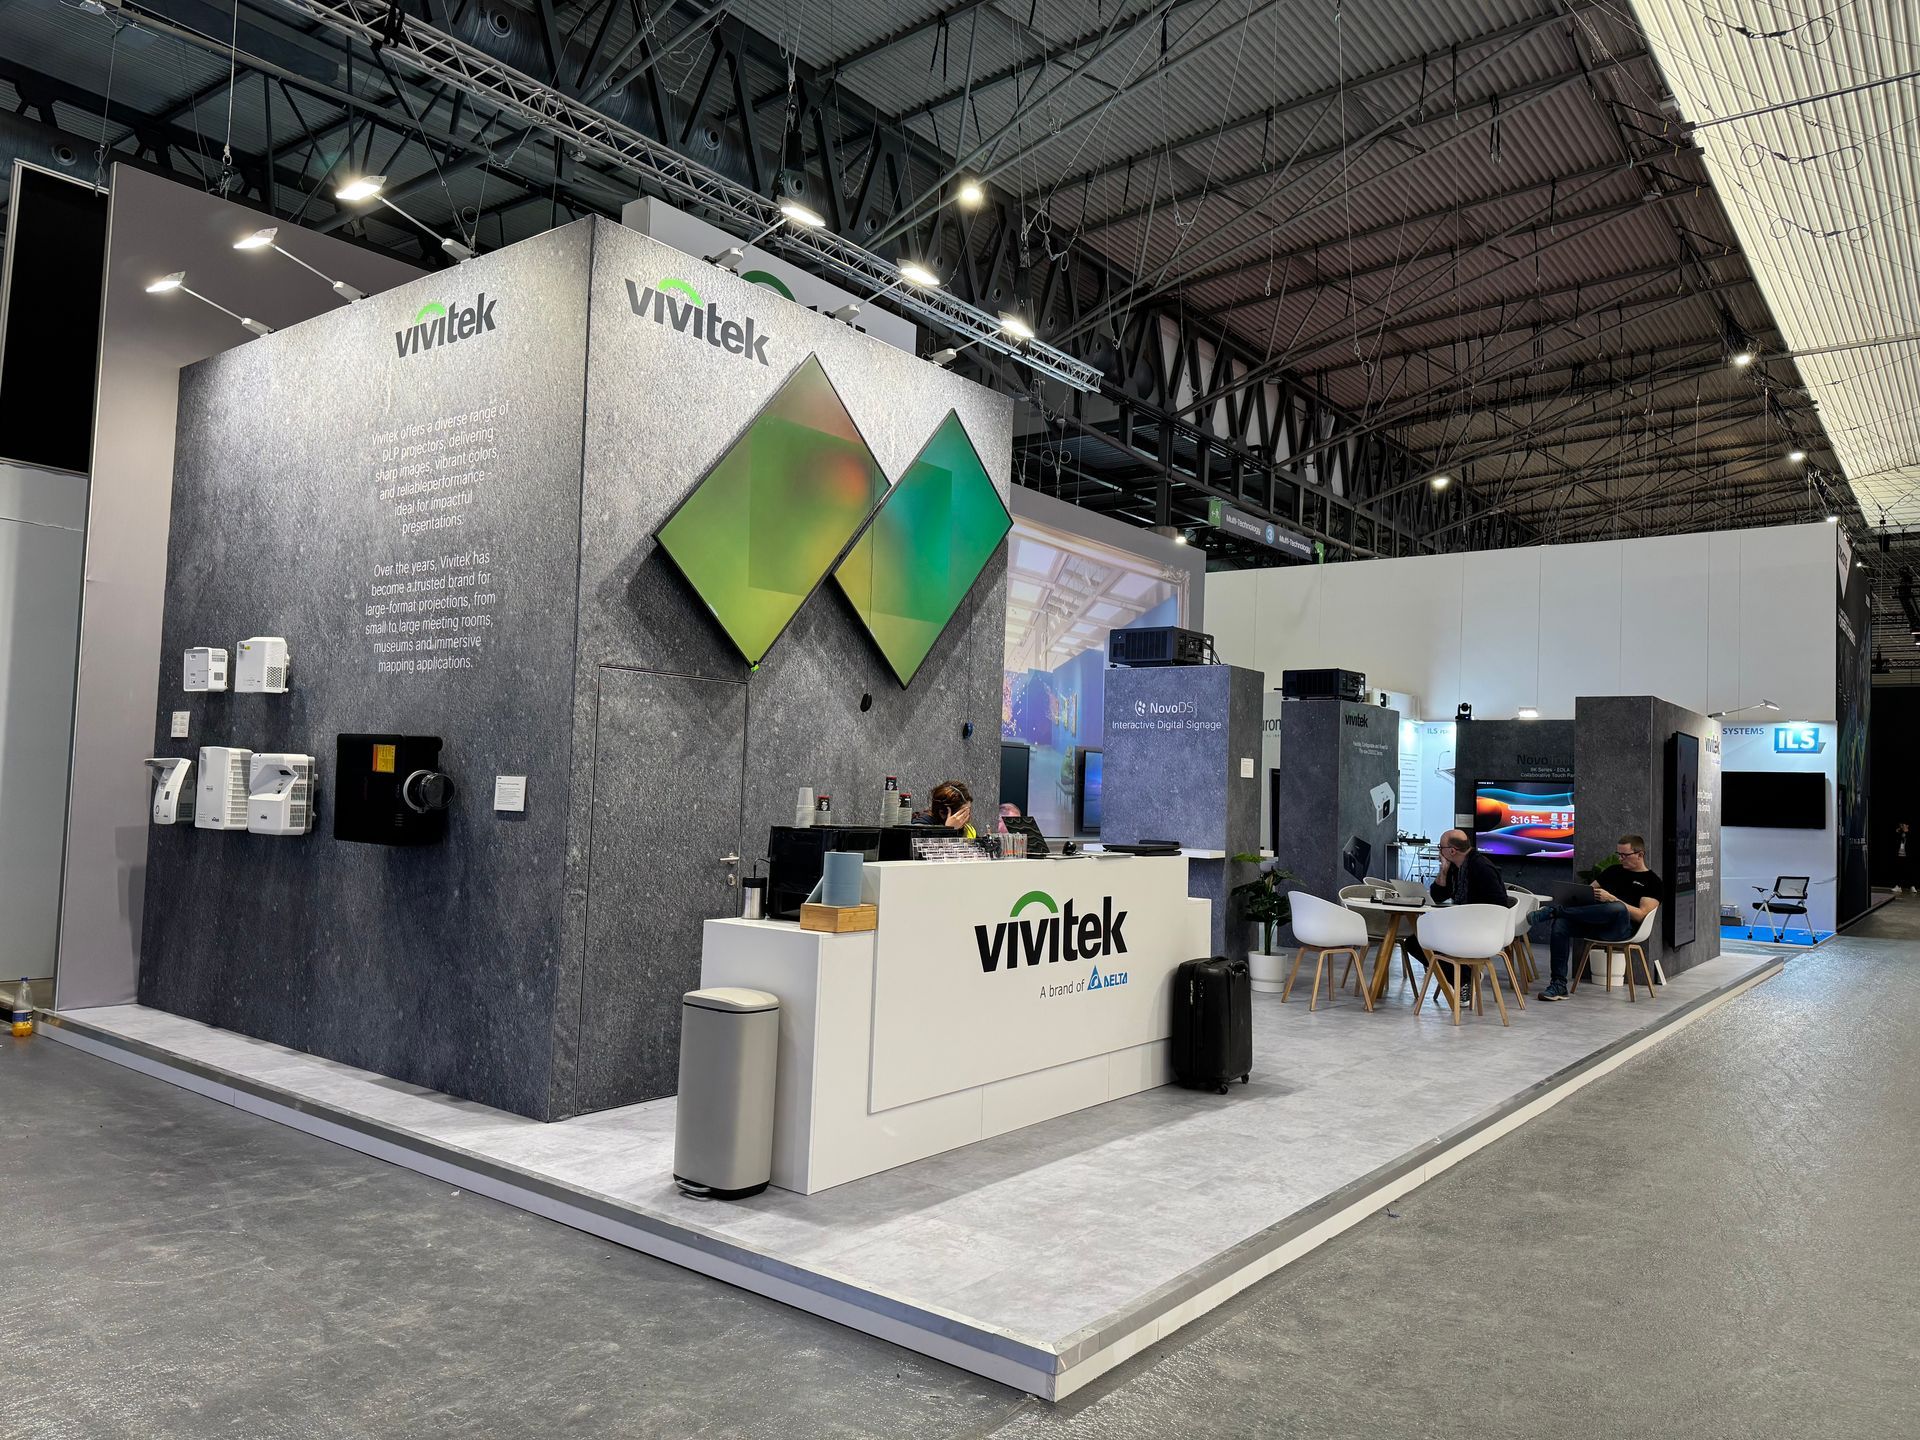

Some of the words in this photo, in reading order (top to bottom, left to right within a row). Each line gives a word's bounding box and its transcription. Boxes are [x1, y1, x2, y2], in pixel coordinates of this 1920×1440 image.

[395, 292, 498, 359] vivitek
[628, 278, 770, 367] vivitek
[371, 429, 399, 447] Vivitek
[400, 422, 425, 440] offers
[427, 422, 433, 433] a
[435, 413, 468, 432] diverse
[469, 408, 497, 427] range
[499, 400, 510, 416] of
[382, 447, 400, 463] DLP
[401, 438, 447, 463] projectors,
[448, 426, 494, 448] delivering
[375, 466, 398, 484] sharp
[400, 459, 433, 480] images,
[435, 450, 467, 470] vibrant
[379, 485, 395, 501] and
[394, 500, 415, 517] ideal
[416, 497, 429, 513] for
[430, 490, 473, 511] impactful
[1225, 514, 1261, 536] Multi-Technology
[1267, 529, 1273, 541] 3
[1278, 535, 1311, 554] Multi-Technology
[374, 563, 394, 578] Over
[395, 560, 410, 575] the
[411, 559, 438, 577] years,
[440, 552, 471, 570] Vivitek
[473, 550, 490, 565] has
[371, 582, 405, 598] become
[406, 583, 413, 593] a
[414, 575, 446, 592] trusted
[448, 572, 476, 589] brand
[477, 570, 491, 585] for
[365, 600, 417, 619] large-format
[418, 594, 472, 615] projections,
[474, 590, 496, 606] from
[365, 620, 387, 636] small
[388, 621, 398, 633] to
[398, 618, 421, 636] large
[422, 614, 460, 633] meeting
[461, 613, 494, 630] rooms,
[373, 638, 414, 654] museums
[415, 636, 432, 651] and
[434, 633, 482, 650] immersive
[378, 659, 415, 676] mapping
[416, 654, 473, 672] applications.
[1150, 702, 1194, 714] NovoDS
[1112, 720, 1155, 730] Interactive
[1157, 720, 1184, 732] Digital
[1186, 720, 1222, 732] Signage
[1345, 713, 1369, 729] vivitek
[1722, 727, 1765, 735] SYSTEMS
[1778, 730, 1816, 749] ILS
[1510, 815, 1530, 825] 3:16
[975, 891, 1128, 973] vivitek
[1040, 986, 1047, 999] A
[1049, 981, 1074, 998] brand
[1076, 979, 1085, 993] of
[1103, 972, 1128, 988] DELTA
